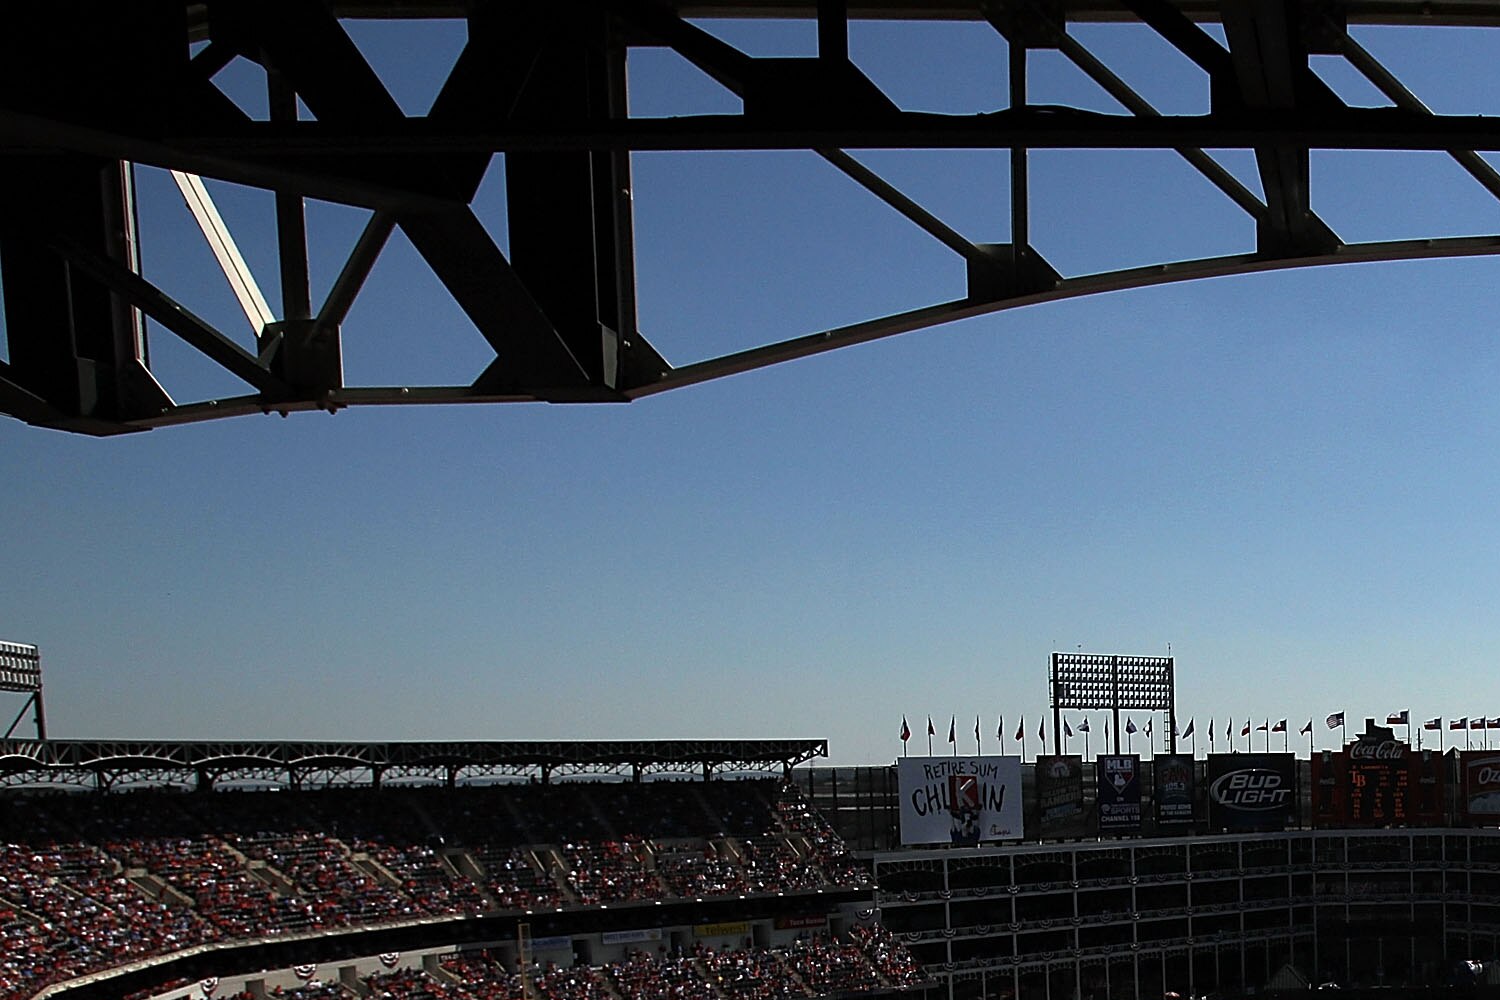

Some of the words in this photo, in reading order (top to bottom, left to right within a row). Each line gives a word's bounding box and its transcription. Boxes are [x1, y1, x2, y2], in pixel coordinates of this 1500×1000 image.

[923, 761, 965, 780] RETIRE
[970, 761, 998, 779] SUM
[1106, 759, 1133, 770] MLB
[1229, 774, 1283, 789] BUD
[1218, 789, 1291, 804] LIGHT
